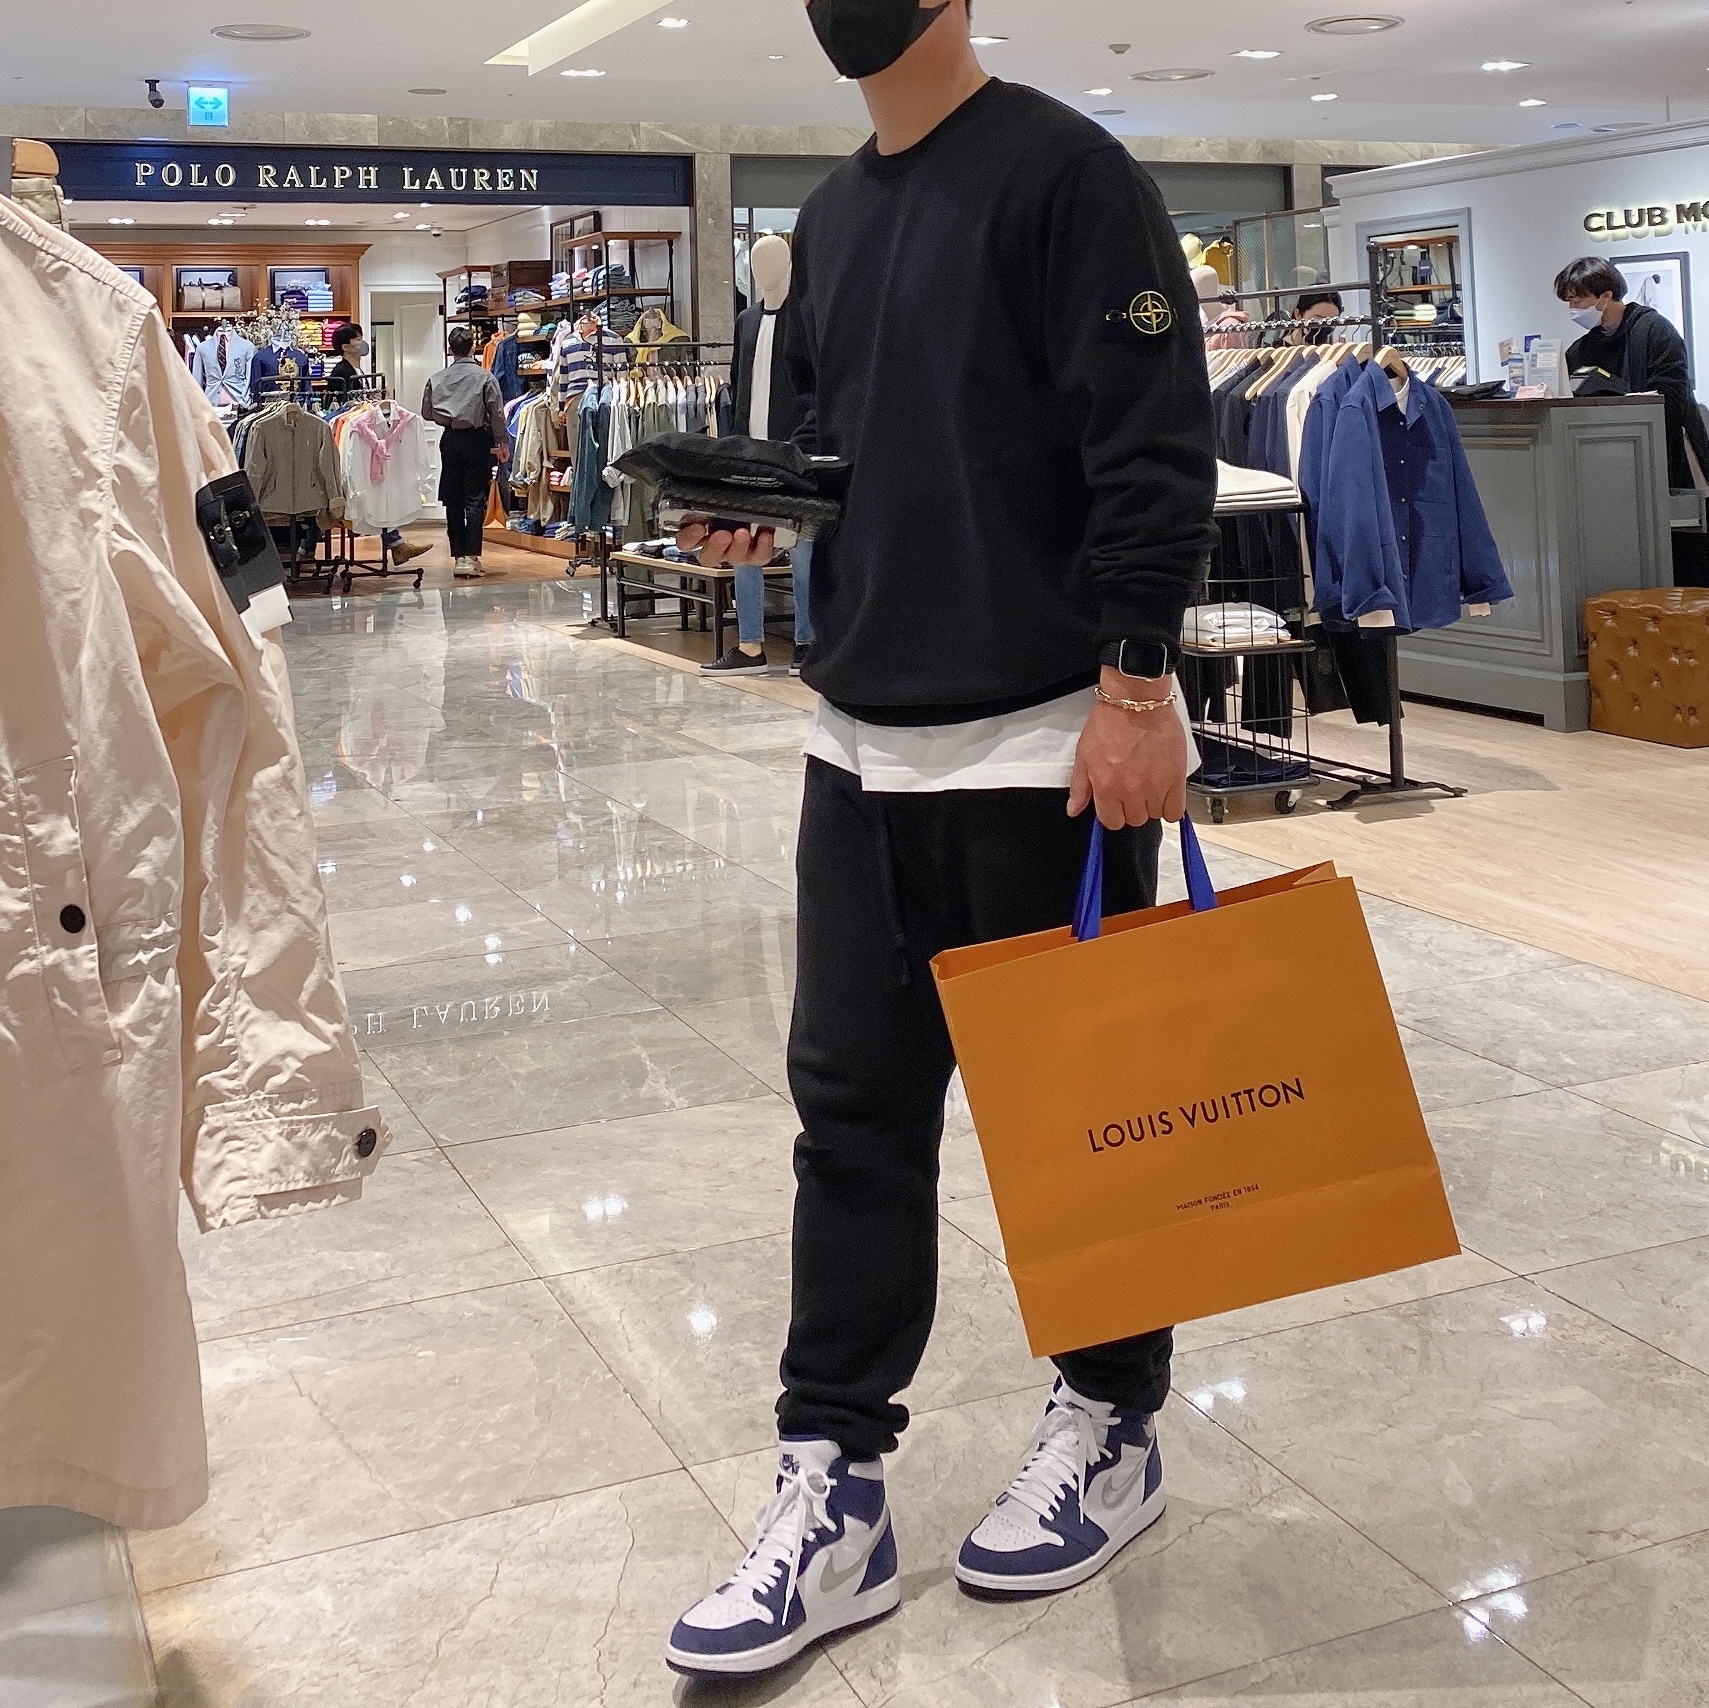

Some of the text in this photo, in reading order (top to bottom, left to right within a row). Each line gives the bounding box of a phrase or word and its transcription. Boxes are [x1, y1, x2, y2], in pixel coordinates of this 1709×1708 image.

[134, 162, 540, 191] POLO RALPH LAUREN
[1583, 206, 1669, 232] CLUB
[1087, 1077, 1305, 1153] LOUIS VUITTON
[1176, 1198, 1203, 1211] MAISON
[1232, 1188, 1242, 1197] EN
[1243, 1183, 1259, 1194] 1854
[1210, 1201, 1230, 1211] PARIS
